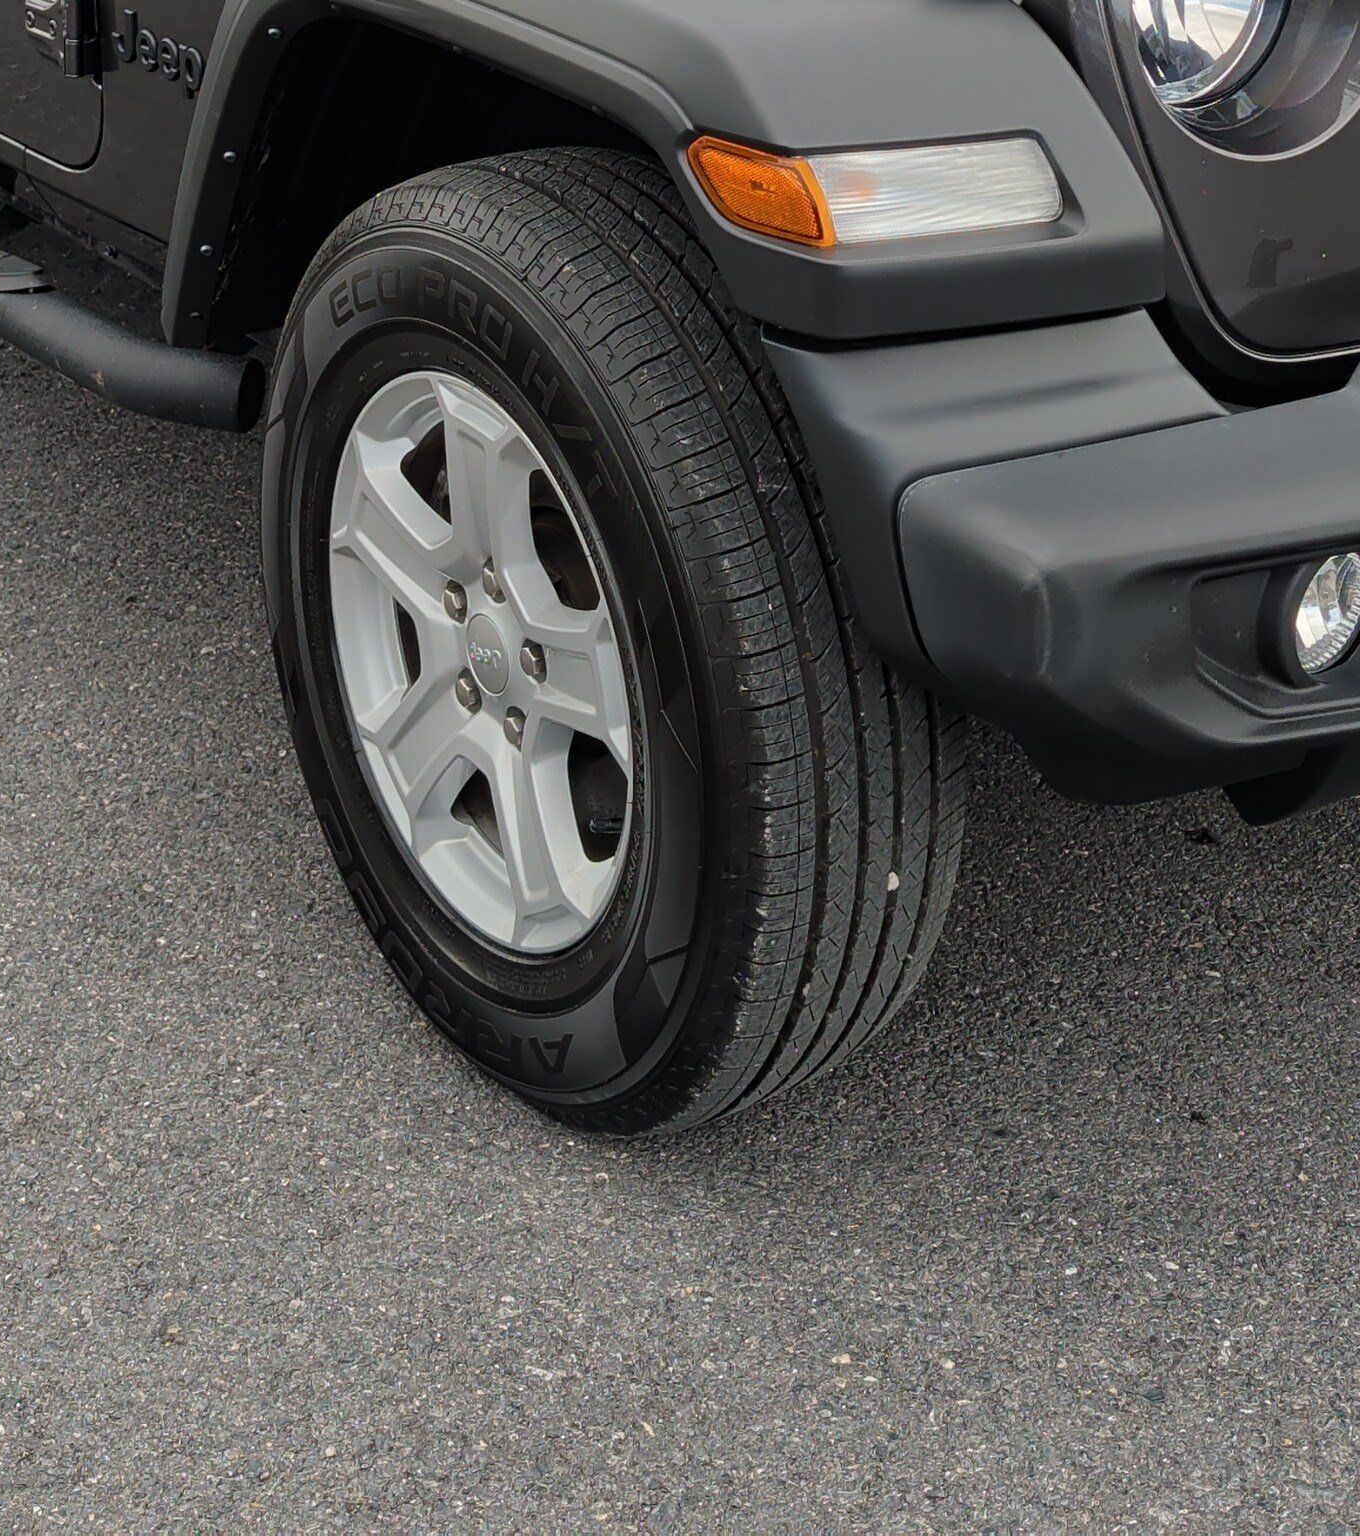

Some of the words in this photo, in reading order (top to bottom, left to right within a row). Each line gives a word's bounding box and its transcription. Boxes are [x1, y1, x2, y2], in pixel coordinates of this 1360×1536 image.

[110, 8, 205, 100] Jeep
[328, 264, 403, 329] ECO
[417, 265, 514, 362] PRO
